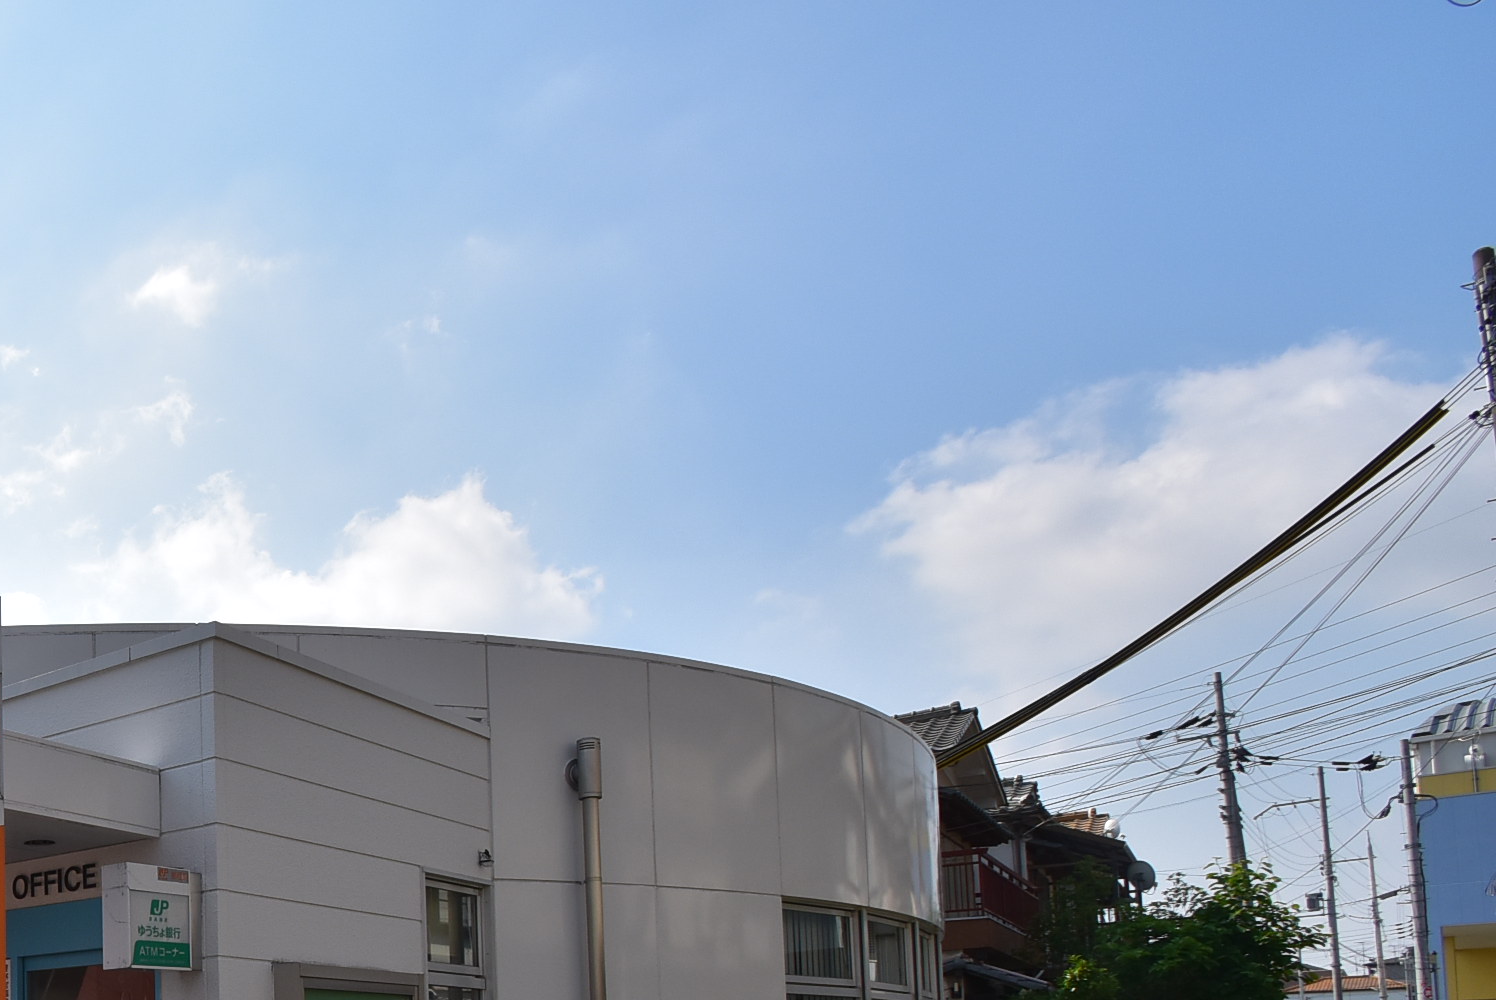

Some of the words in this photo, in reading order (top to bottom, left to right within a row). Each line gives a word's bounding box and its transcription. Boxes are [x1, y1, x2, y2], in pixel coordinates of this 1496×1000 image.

[12, 863, 97, 900] OFFICE
[150, 899, 169, 915] JP
[138, 925, 181, 939] ゆうちょ銀行
[139, 946, 185, 957] ATMコーナー
